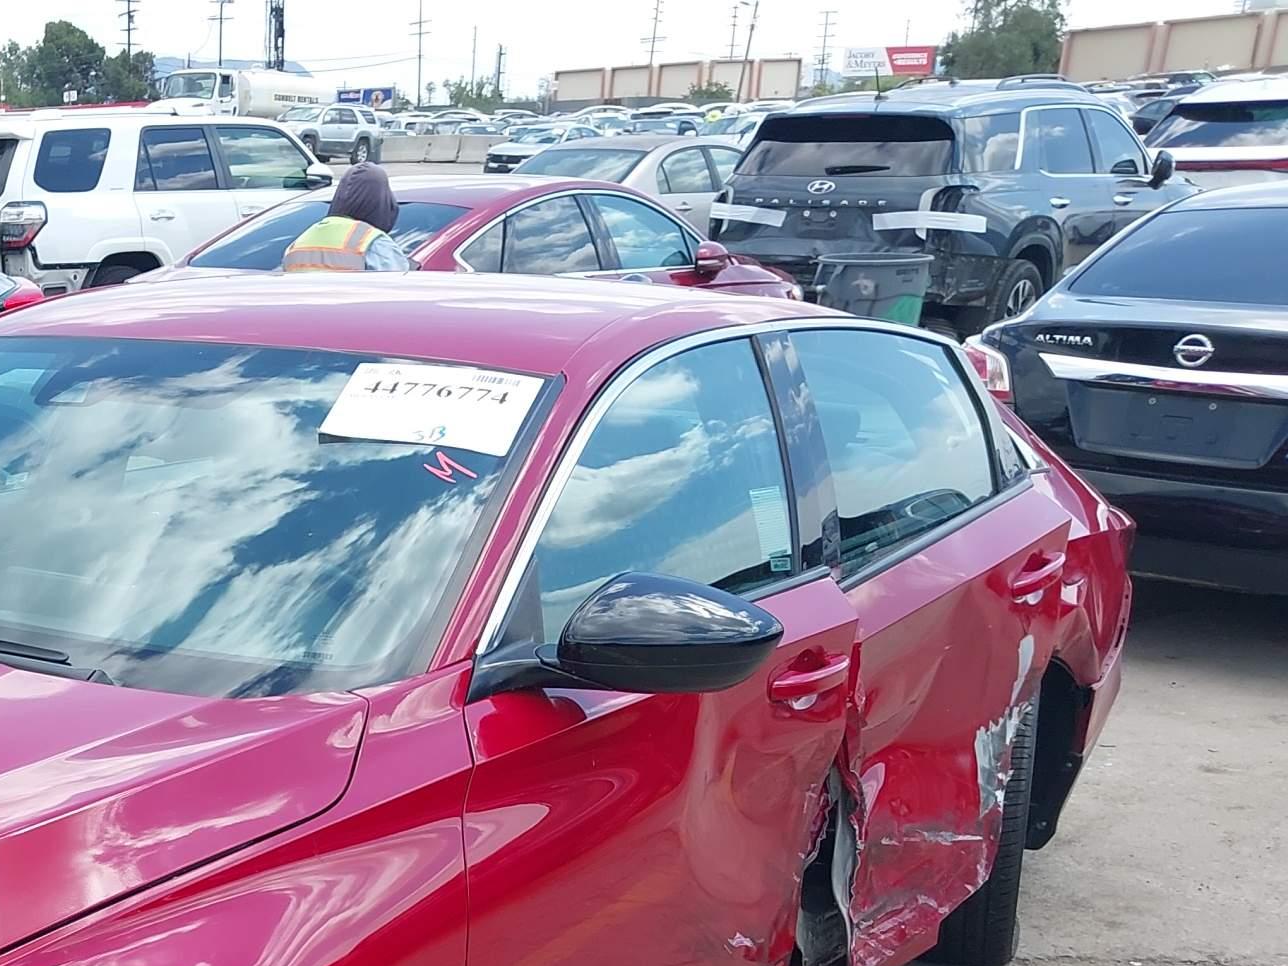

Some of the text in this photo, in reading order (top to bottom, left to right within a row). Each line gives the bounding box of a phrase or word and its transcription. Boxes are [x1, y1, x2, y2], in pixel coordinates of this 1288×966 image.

[755, 197, 888, 206] PALISADE
[1035, 334, 1093, 347] ALTIMA
[364, 379, 510, 406] 44776774
